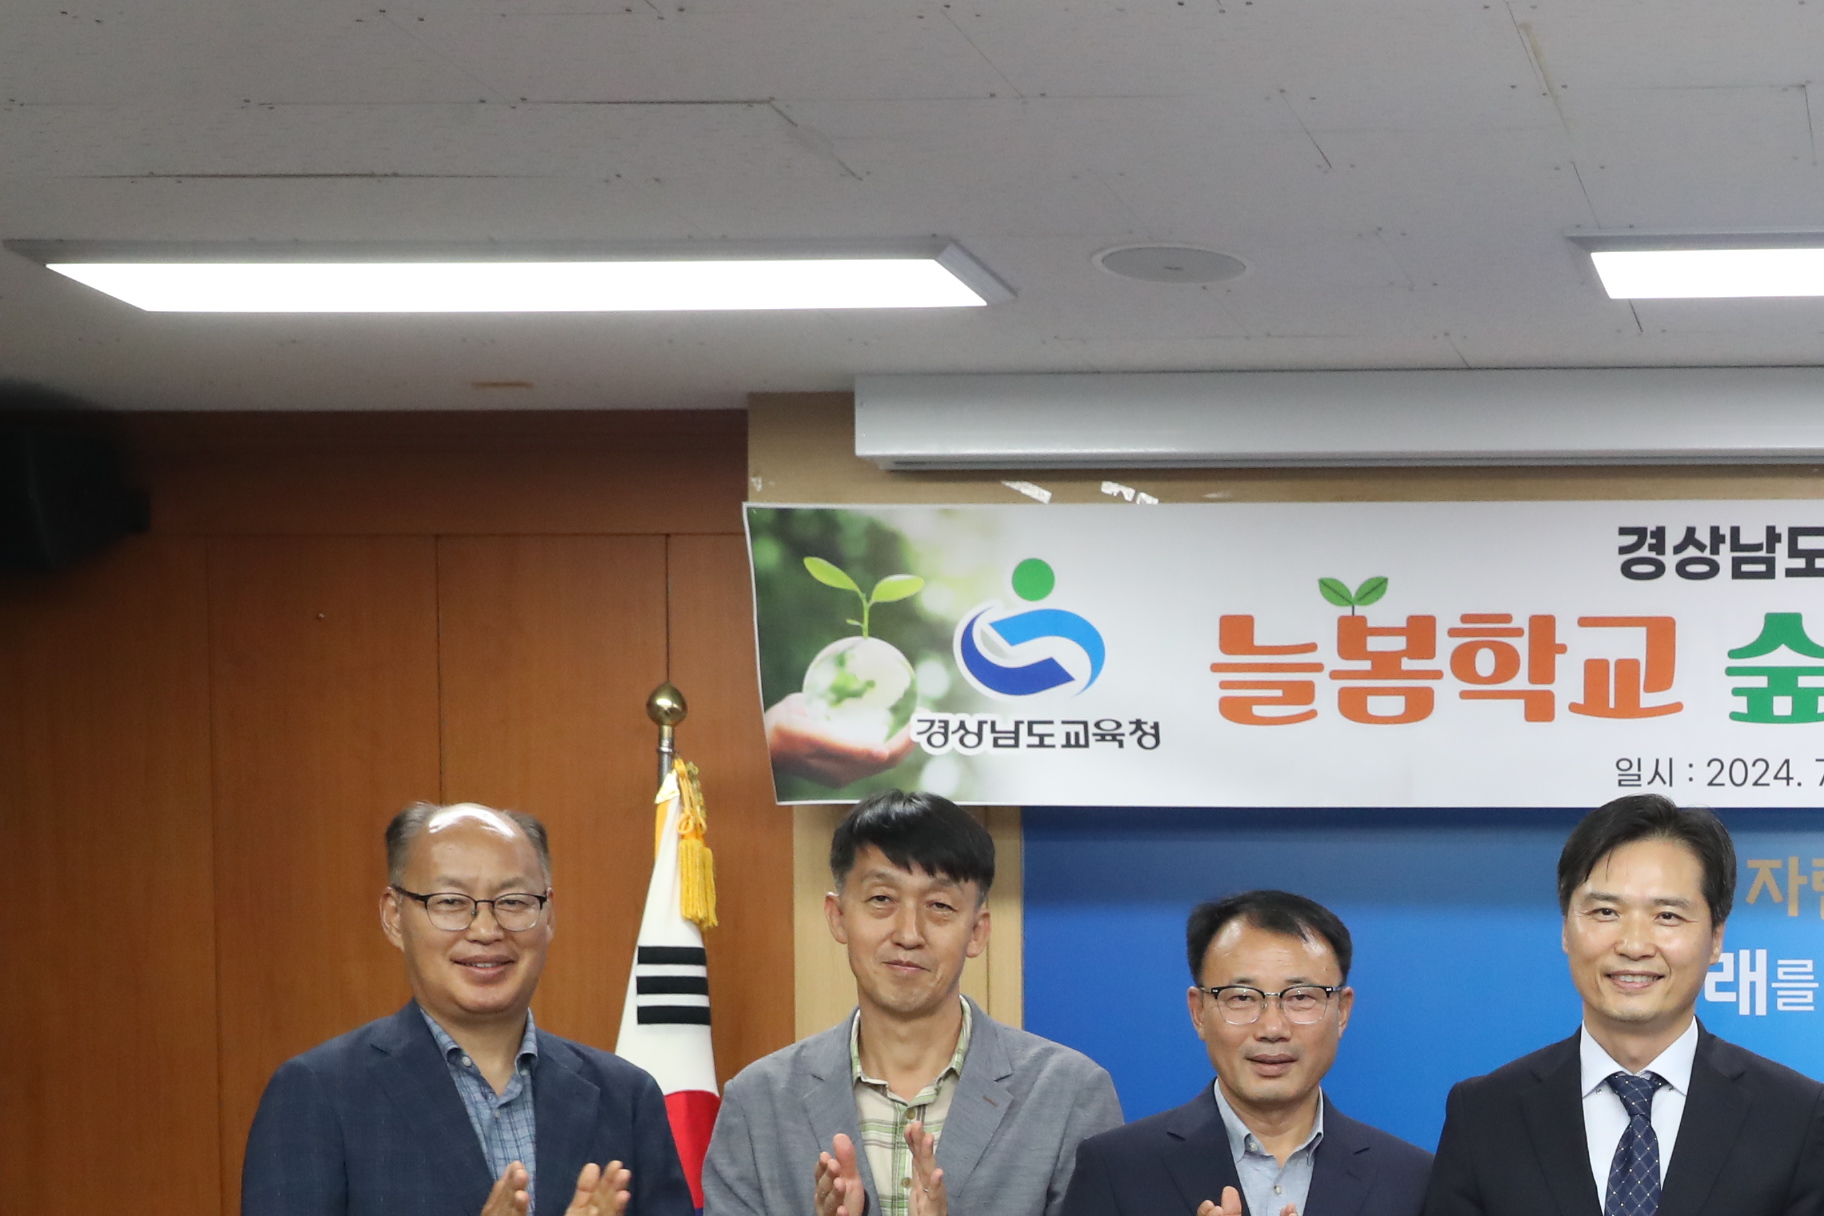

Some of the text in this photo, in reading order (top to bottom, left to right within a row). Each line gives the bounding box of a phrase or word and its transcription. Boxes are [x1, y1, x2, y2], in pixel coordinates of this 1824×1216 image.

[1210, 613, 1684, 726] 늘봄학교
[914, 717, 1162, 751] 경상남도교육청
[1615, 757, 1673, 788] 일시
[1706, 757, 1802, 788] 2024.
[1704, 948, 1819, 1016] 래를
